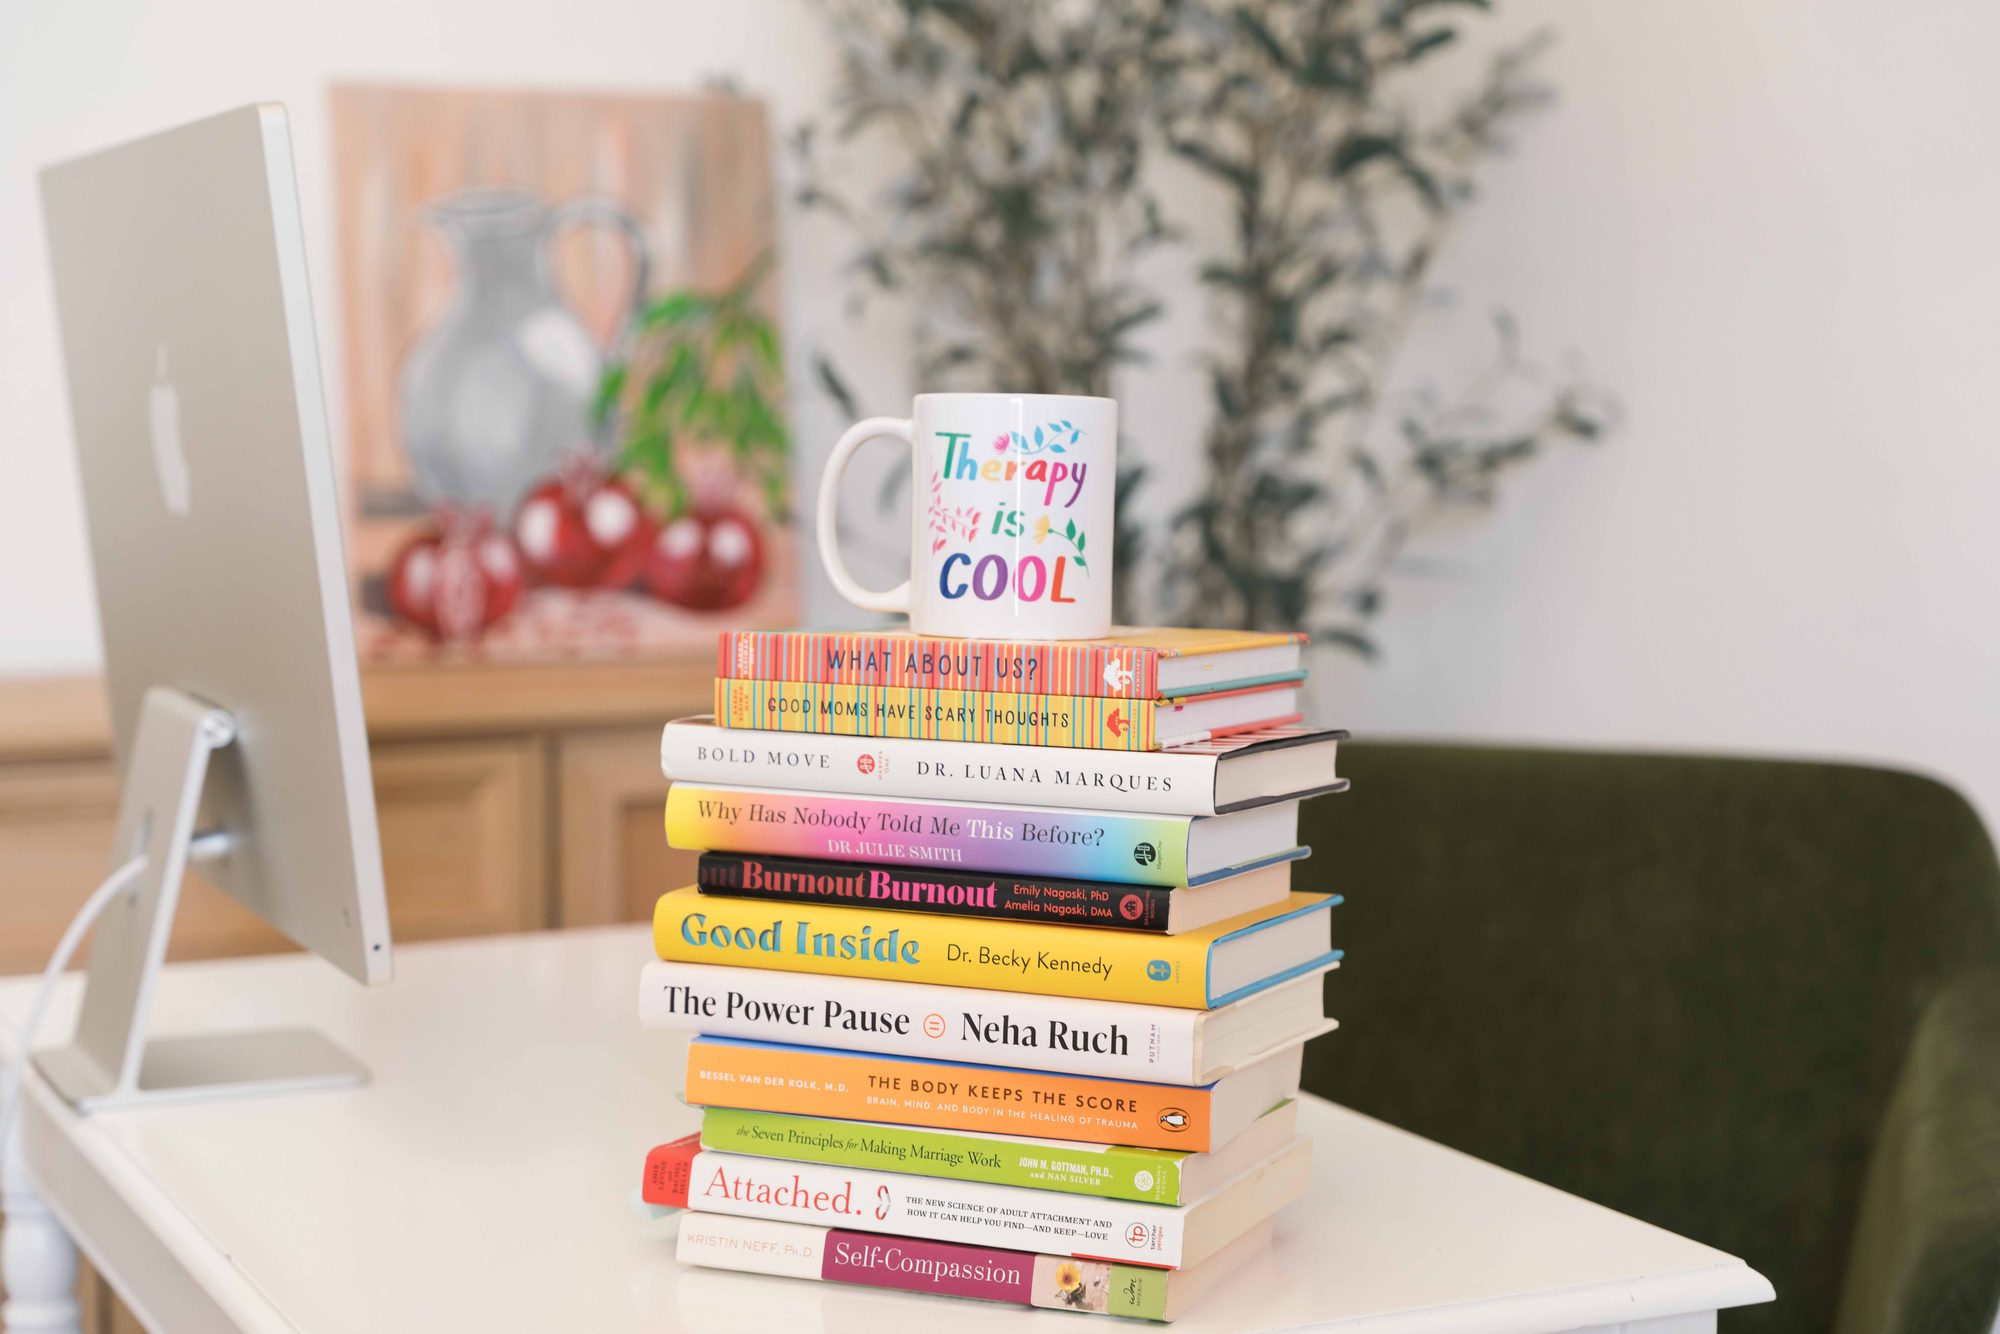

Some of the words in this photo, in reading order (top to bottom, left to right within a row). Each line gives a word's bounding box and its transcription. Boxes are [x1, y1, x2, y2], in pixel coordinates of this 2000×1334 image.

[935, 431, 1087, 508] Therapy
[991, 502, 1025, 538] is
[939, 552, 1077, 603] COOL
[827, 649, 892, 673] WHAT
[905, 652, 982, 677] ABOUT
[997, 657, 1038, 680] US?
[768, 697, 811, 713] GOOD
[821, 700, 867, 717] MOMS
[876, 703, 915, 719] HAVE
[925, 706, 976, 722] SCARY
[985, 708, 1069, 728] THOUGHTS
[697, 746, 756, 764] BOLD
[767, 751, 831, 769] MOVE
[917, 761, 953, 777] DR.
[964, 764, 1042, 784] LUANA
[1055, 769, 1173, 792] MARQUES
[698, 800, 743, 825] Why
[749, 803, 786, 824] Has
[793, 807, 871, 834] Nobody
[877, 812, 922, 834] Told
[930, 817, 960, 837] Me
[967, 818, 1014, 840] This
[1022, 823, 1105, 847] Before?
[827, 839, 851, 854] DR
[855, 841, 904, 859] JULIE
[909, 845, 963, 863] SMITH
[742, 860, 866, 898] Burnout
[867, 870, 998, 908] Burnout
[1013, 884, 1041, 898] Emily
[1043, 887, 1088, 901] Nagoski,
[1090, 891, 1109, 902] PhD
[1004, 899, 1040, 912] Amelia
[1043, 902, 1088, 916] Nagoski,
[1090, 906, 1113, 918] DMA
[681, 913, 782, 952] Good
[796, 920, 921, 964] Inside
[947, 943, 972, 963] Dr.
[979, 946, 1031, 974] Becky
[1037, 951, 1113, 981] Kennedy
[664, 985, 717, 1017] The
[726, 991, 814, 1026] Power
[824, 1000, 911, 1035] Pause
[961, 1012, 1037, 1047] Neha
[1049, 1020, 1128, 1056] Ruch
[1148, 1023, 1157, 1063] PUTNAM
[699, 1070, 736, 1083] BESSEL
[739, 1074, 762, 1085] VAN
[764, 1076, 784, 1087] DER
[788, 1078, 821, 1091] KOLK,
[825, 1081, 849, 1093] M.D.
[868, 1075, 901, 1090] THE
[910, 1079, 960, 1095] BODY
[968, 1084, 1023, 1101] KEEPS
[1032, 1090, 1066, 1106] THE
[1076, 1095, 1138, 1113] SCORE
[866, 1095, 900, 1107] BRAIN,
[903, 1099, 934, 1111] MIND,
[937, 1103, 959, 1113] AND
[962, 1105, 990, 1116] BODY
[993, 1108, 1004, 1117] IN
[1008, 1110, 1025, 1120] THE
[1030, 1112, 1075, 1124] HEALING
[1079, 1116, 1092, 1126] OF
[1095, 1117, 1138, 1129] TRAUMA
[736, 1125, 750, 1137] the
[751, 1126, 784, 1142] Seven
[788, 1129, 844, 1151] Principles
[844, 1138, 859, 1151] for
[860, 1138, 907, 1159] Making
[910, 1140, 964, 1163] Marriage
[967, 1150, 1001, 1169] Work
[651, 1163, 659, 1185] AMIR
[658, 1161, 667, 1190] LEVINE
[672, 1160, 682, 1194] RACHEL
[679, 1161, 689, 1194] HELLER
[1018, 1156, 1037, 1169] JOHN
[1038, 1159, 1049, 1170] M.
[1050, 1160, 1088, 1175] GOTTMAN,
[1030, 1170, 1045, 1180] and
[1047, 1172, 1067, 1182] NAN
[1068, 1174, 1102, 1187] SILVER
[704, 1165, 863, 1216] Attached.
[905, 1196, 923, 1206] THE
[925, 1198, 946, 1208] NEW
[947, 1200, 985, 1213] SCIENCE
[986, 1205, 998, 1214] OF
[1000, 1206, 1029, 1218] ADULT
[1030, 1210, 1091, 1226] ATTACHMENT
[1093, 1218, 1112, 1229] AND
[907, 1208, 927, 1219] HOW
[929, 1210, 938, 1219] IT
[939, 1212, 958, 1222] CAN
[960, 1214, 983, 1225] HELP
[984, 1217, 1002, 1227] YOU
[687, 1233, 738, 1249] KRISTIN
[742, 1240, 780, 1255] NEFF,
[1128, 1225, 1145, 1243] tp
[834, 1241, 1021, 1285] Self-Compassion
